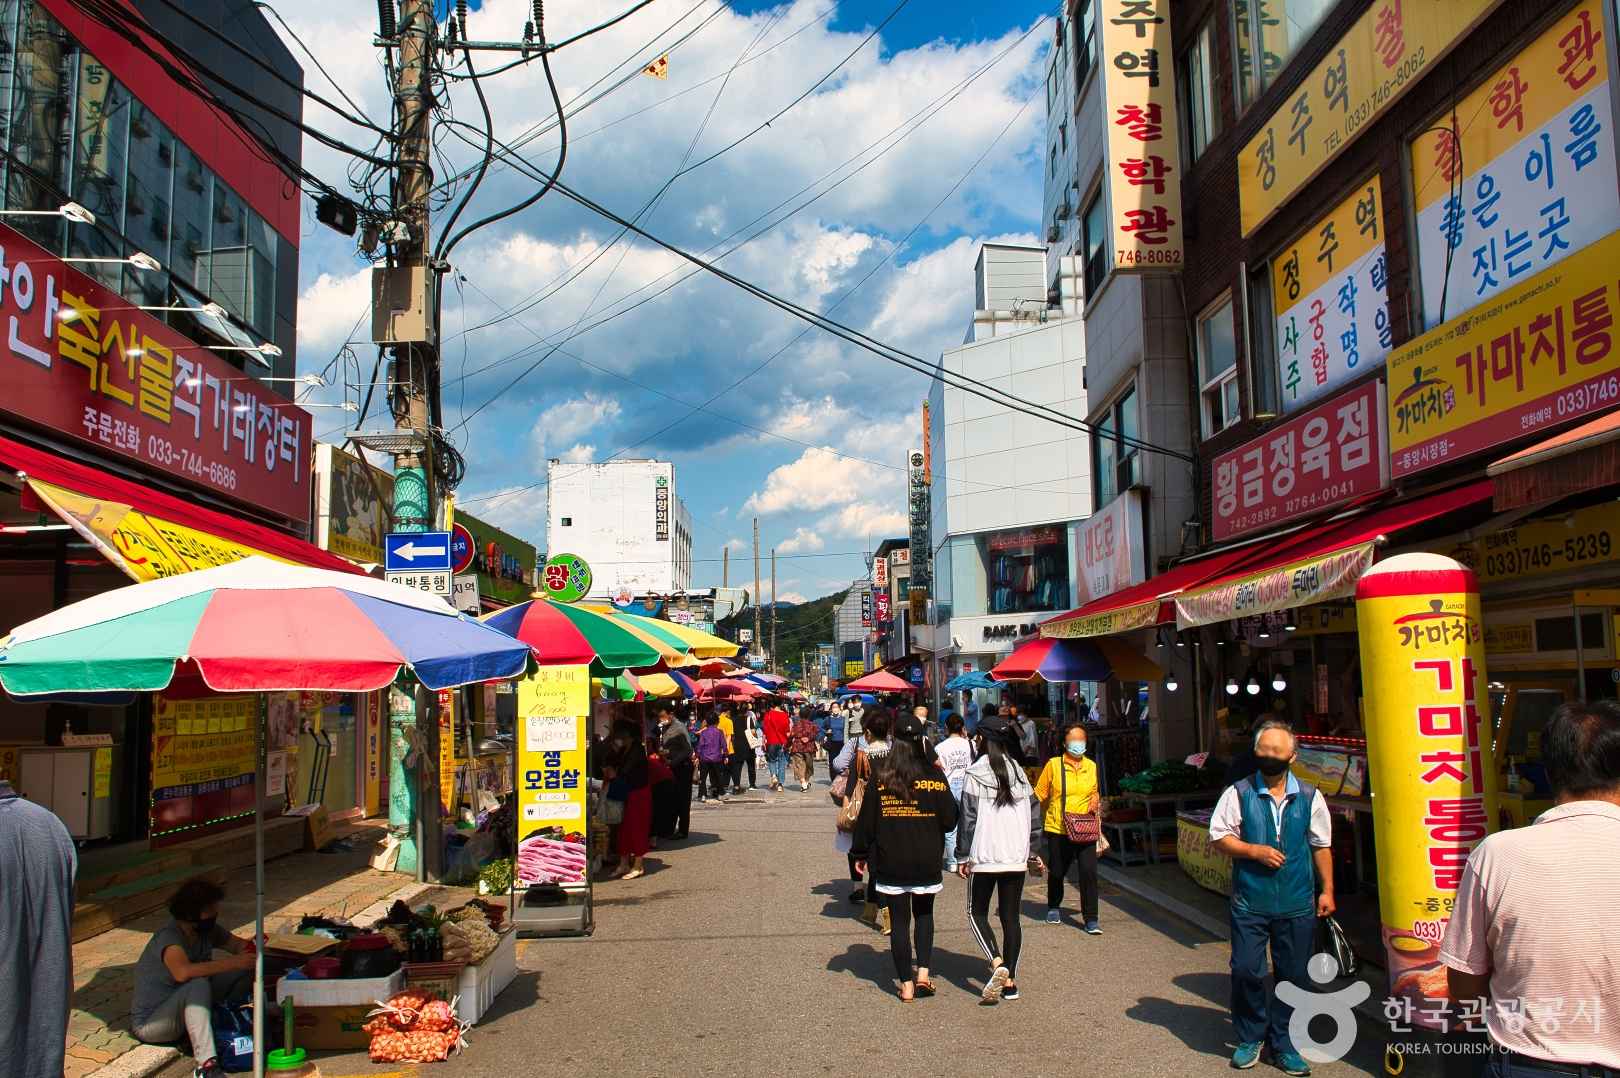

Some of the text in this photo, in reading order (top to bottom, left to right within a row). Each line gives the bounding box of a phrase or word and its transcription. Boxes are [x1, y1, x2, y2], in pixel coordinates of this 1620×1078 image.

[1323, 129, 1342, 155] TEL
[1455, 284, 1620, 408] 가마치통
[1396, 387, 1443, 434] 가마치
[82, 406, 238, 490] 주문전화 033-744-6686
[1216, 395, 1372, 518] 황금정육점
[1486, 531, 1612, 577] 033)746-5239
[1398, 619, 1472, 650] 가마치
[1414, 918, 1450, 940] 033)
